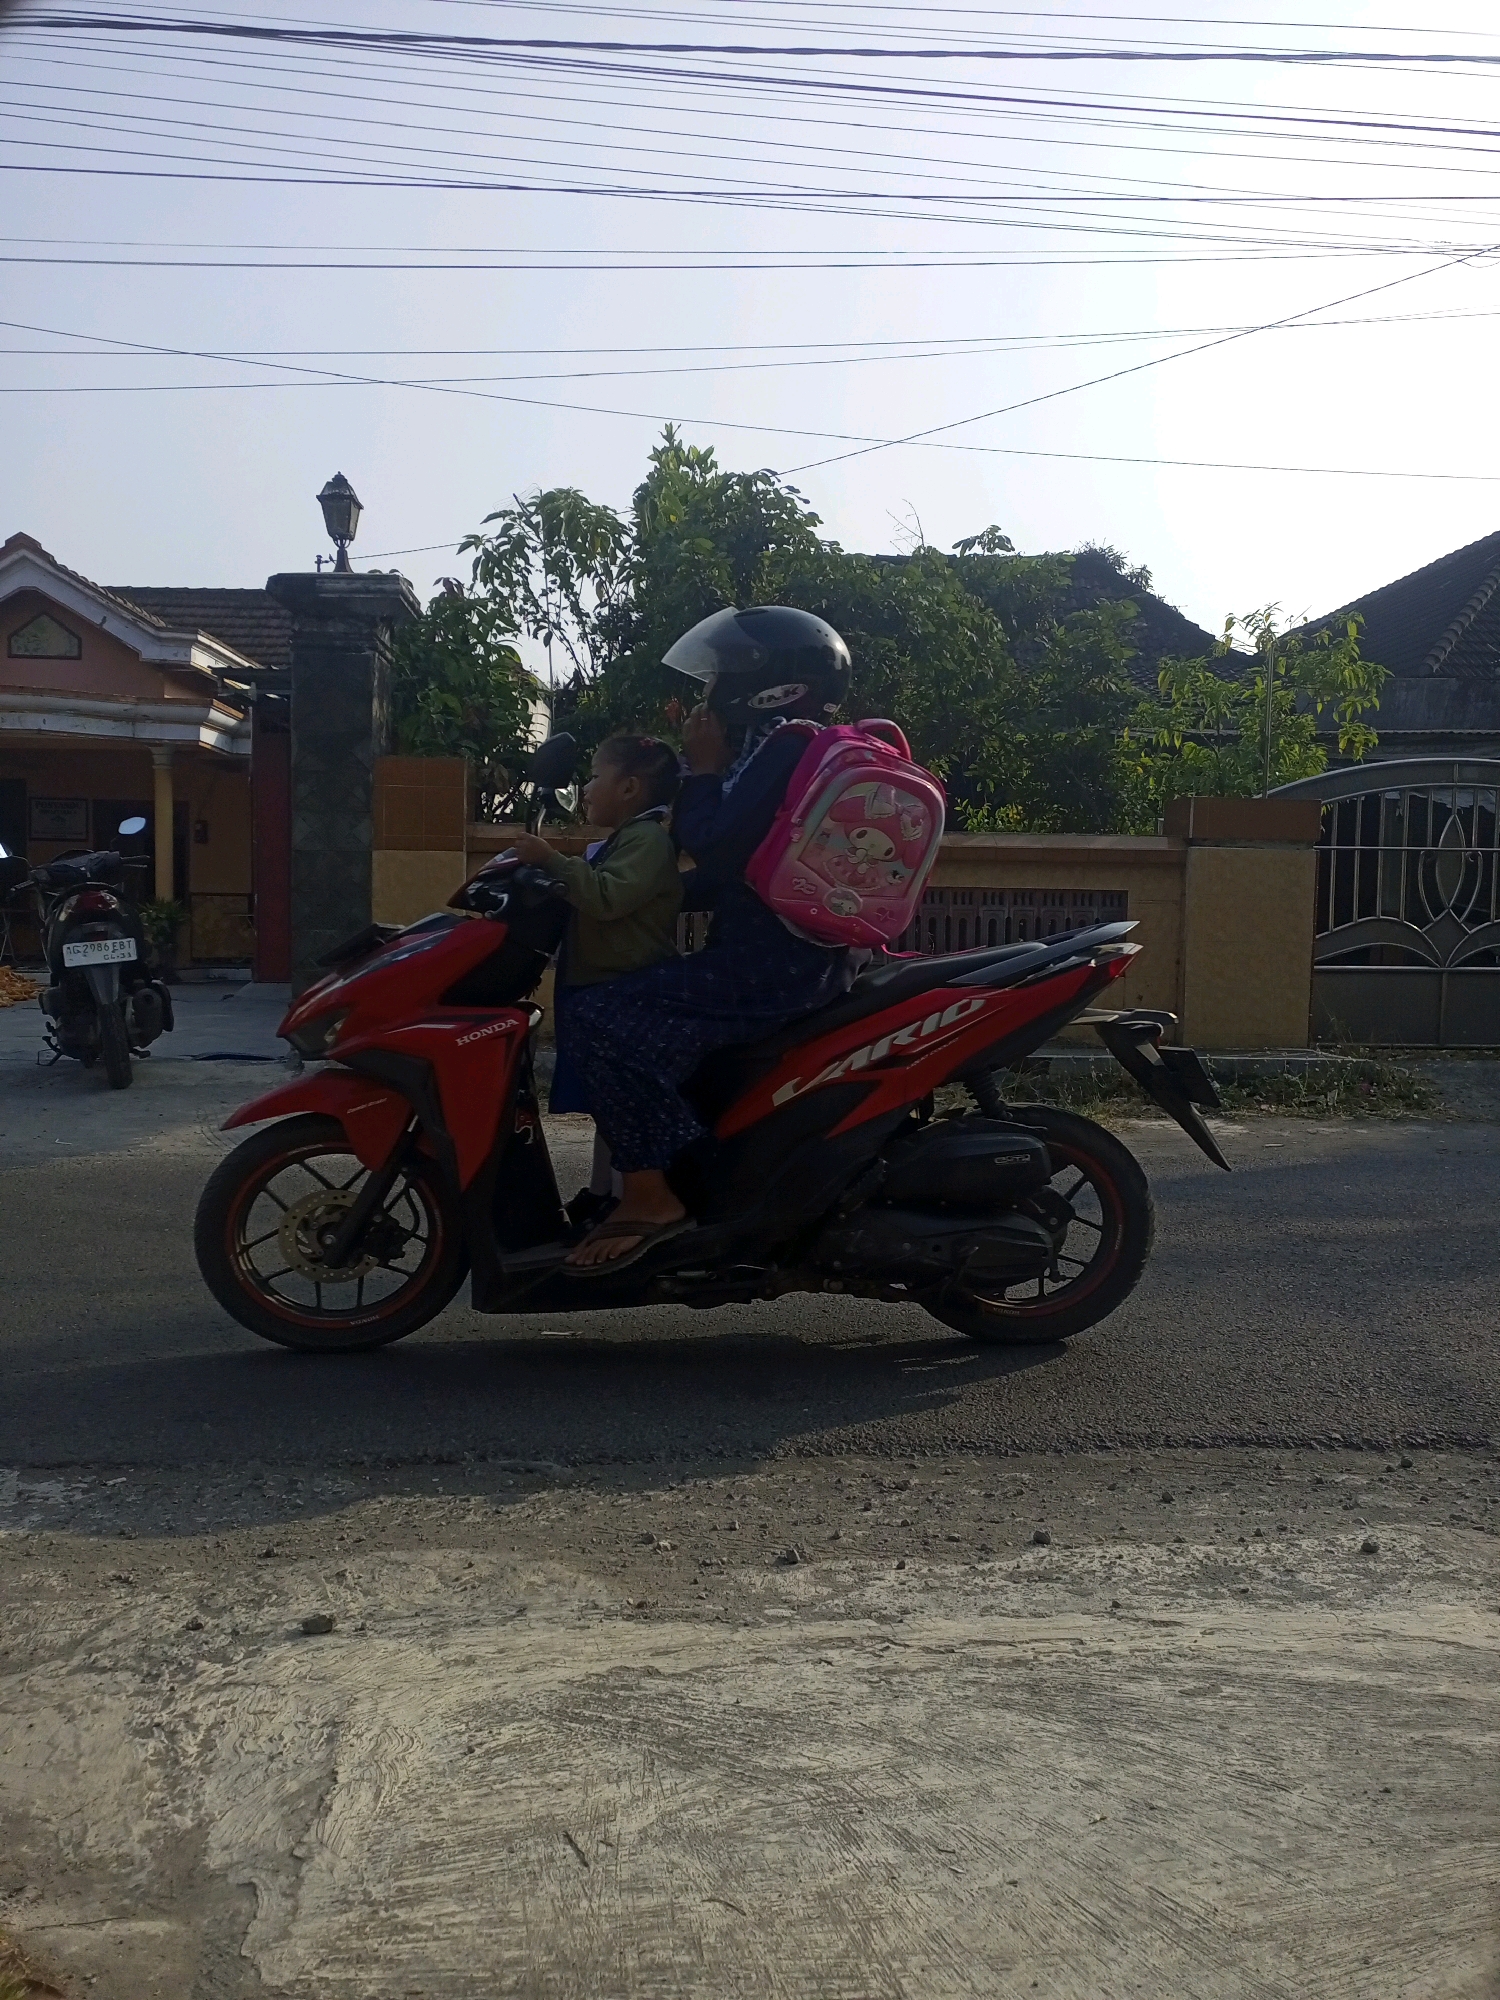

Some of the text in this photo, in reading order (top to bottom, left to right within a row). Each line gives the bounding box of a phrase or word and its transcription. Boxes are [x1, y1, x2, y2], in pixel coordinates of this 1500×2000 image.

[455, 1018, 519, 1047] HONDA
[771, 999, 986, 1107] VARIO
[349, 1314, 380, 1326] HONDA
